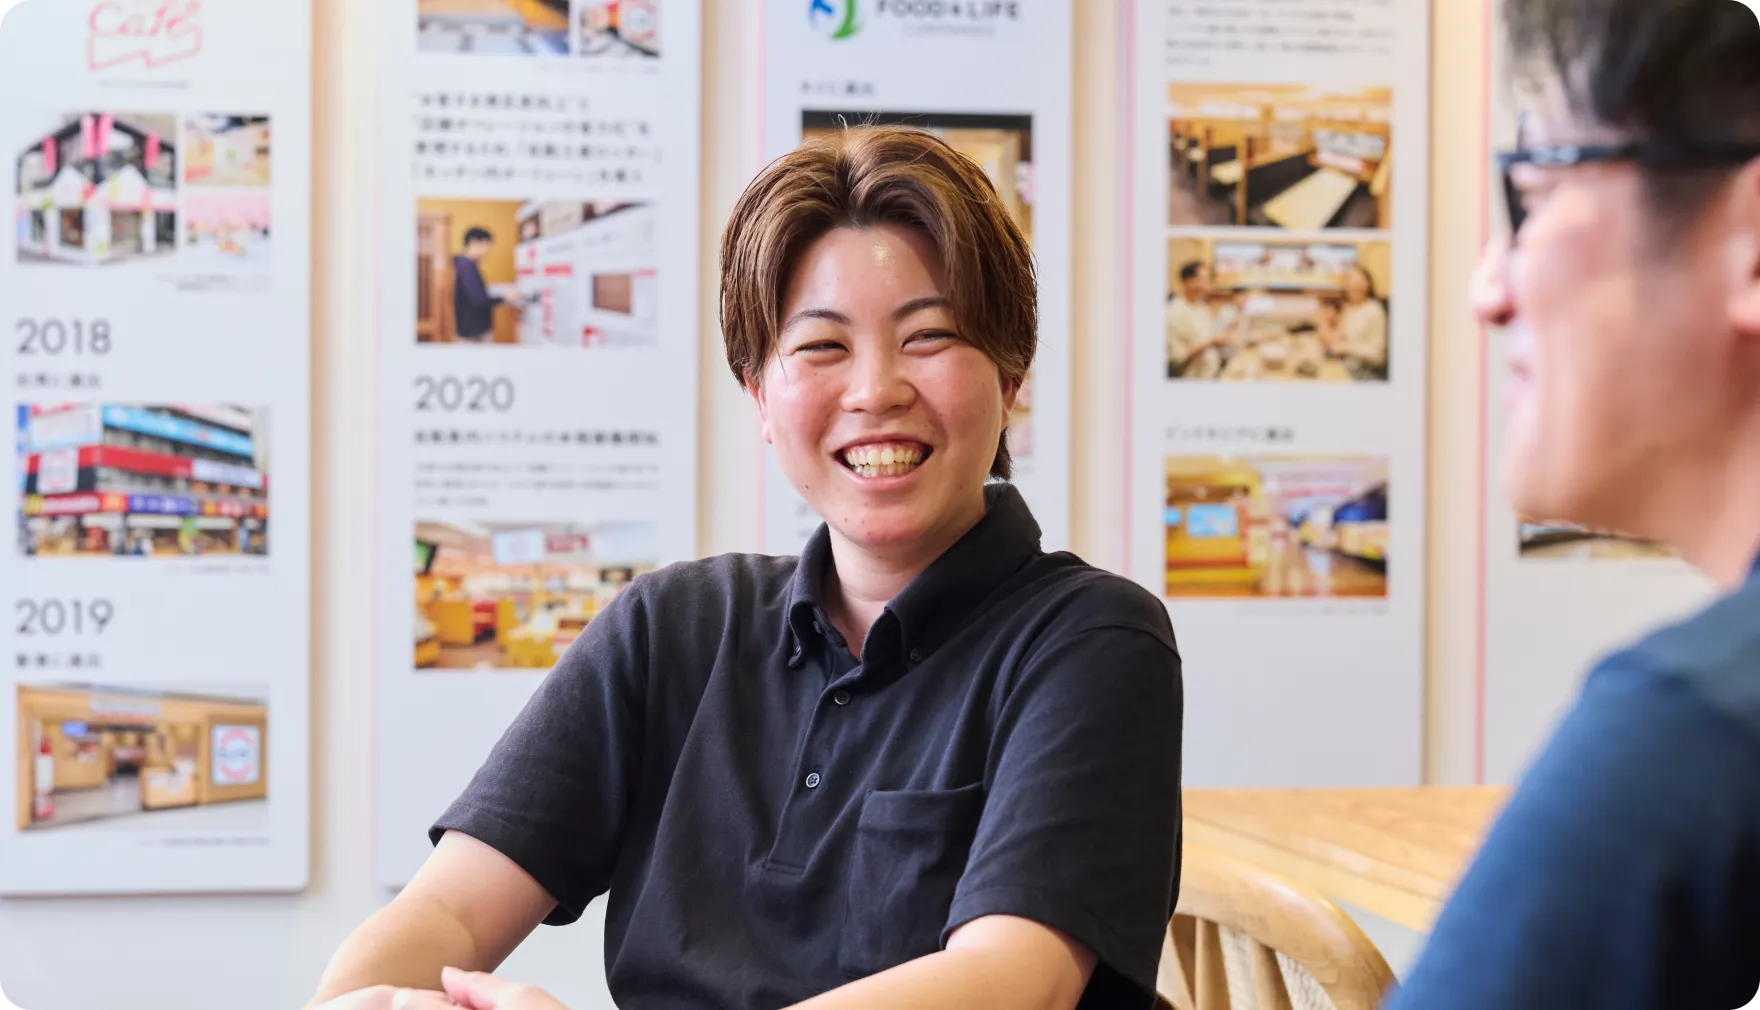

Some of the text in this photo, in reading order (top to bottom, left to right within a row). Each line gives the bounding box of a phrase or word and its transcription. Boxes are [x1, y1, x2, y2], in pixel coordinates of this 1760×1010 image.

[967, 0, 1018, 20] LIFE
[15, 318, 112, 356] 2018
[414, 375, 515, 412] 2020
[16, 598, 114, 635] 2019
